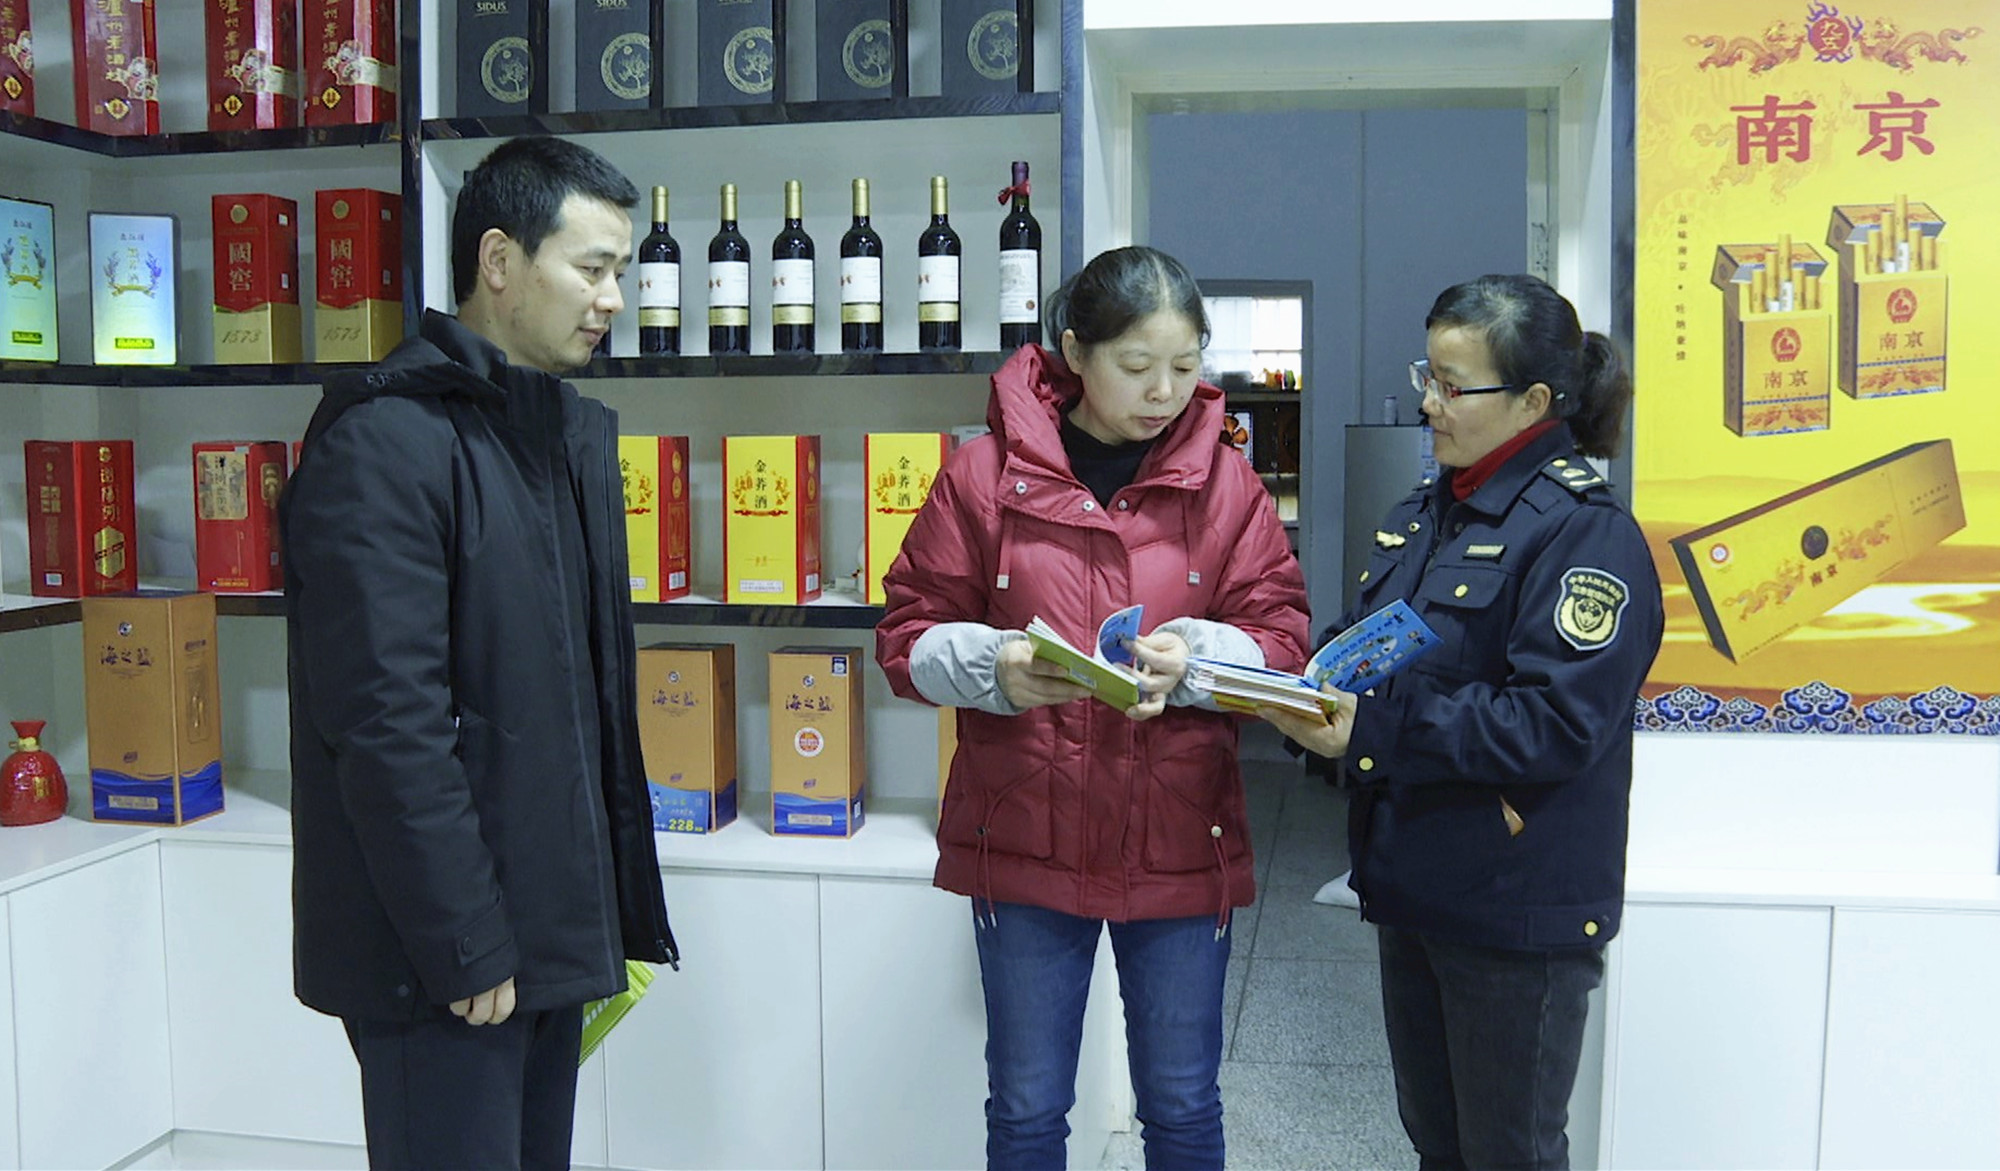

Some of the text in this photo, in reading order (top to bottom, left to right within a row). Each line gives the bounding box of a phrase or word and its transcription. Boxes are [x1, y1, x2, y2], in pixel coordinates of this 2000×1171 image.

[1729, 91, 1941, 166] 南京
[222, 330, 261, 344] 1573
[323, 326, 361, 341] 1573
[1879, 330, 1925, 352] 南京
[1763, 369, 1809, 390] 南京
[668, 818, 694, 832] 228
